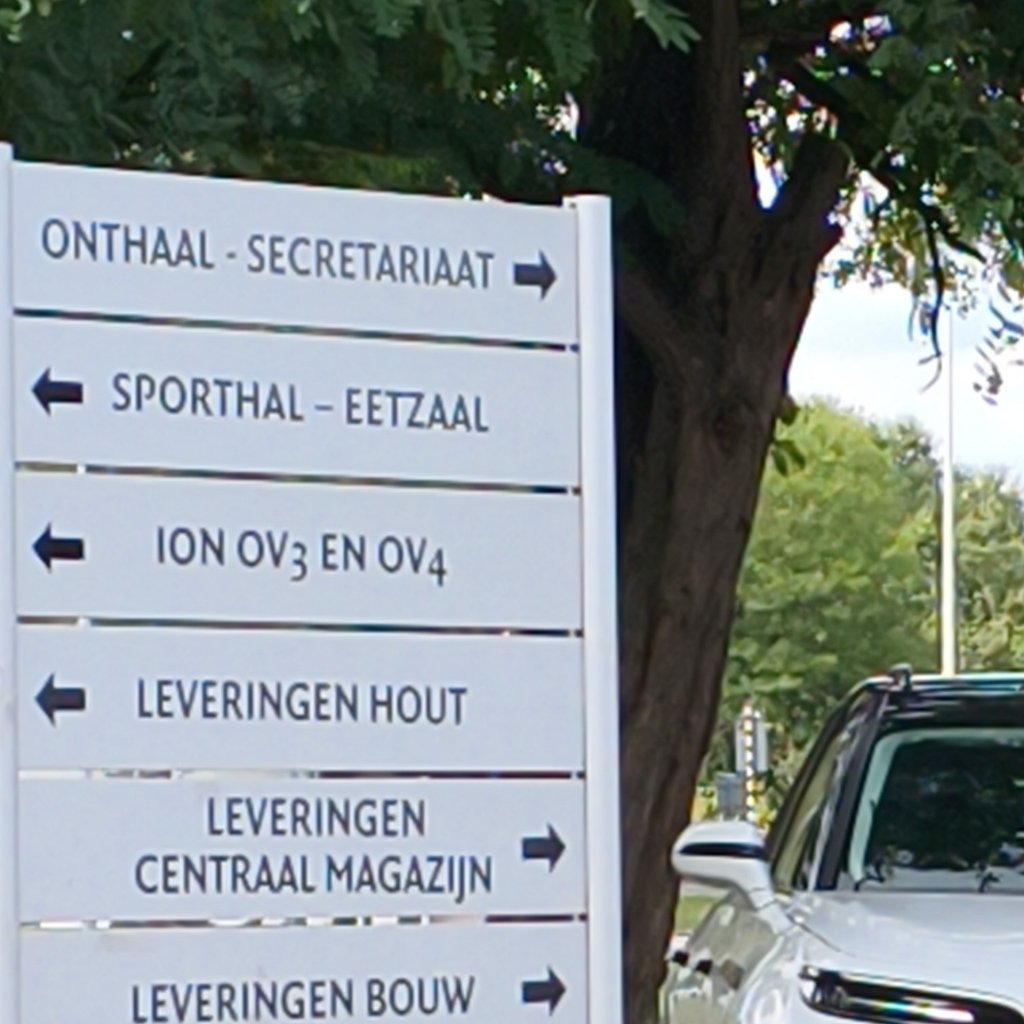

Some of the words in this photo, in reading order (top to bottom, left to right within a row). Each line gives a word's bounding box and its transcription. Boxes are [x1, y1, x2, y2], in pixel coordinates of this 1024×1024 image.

[41, 218, 215, 270] ONTHAAL
[247, 233, 495, 289] SECRETARIAAT
[111, 372, 305, 422] SPORTHAL
[346, 387, 490, 433] EETZAAL
[157, 526, 225, 566] ION
[236, 529, 308, 584] OV3
[321, 532, 366, 572] EN
[377, 535, 447, 588] OV4
[137, 678, 359, 722] LEVERINGEN
[370, 684, 468, 726] HOUT
[207, 796, 425, 838] LEVERINGEN
[134, 853, 317, 895] CENTRAAL
[325, 854, 492, 905] MAGAZIJN
[132, 978, 354, 1024] LEVERINGEN
[366, 975, 476, 1018] BOUW
